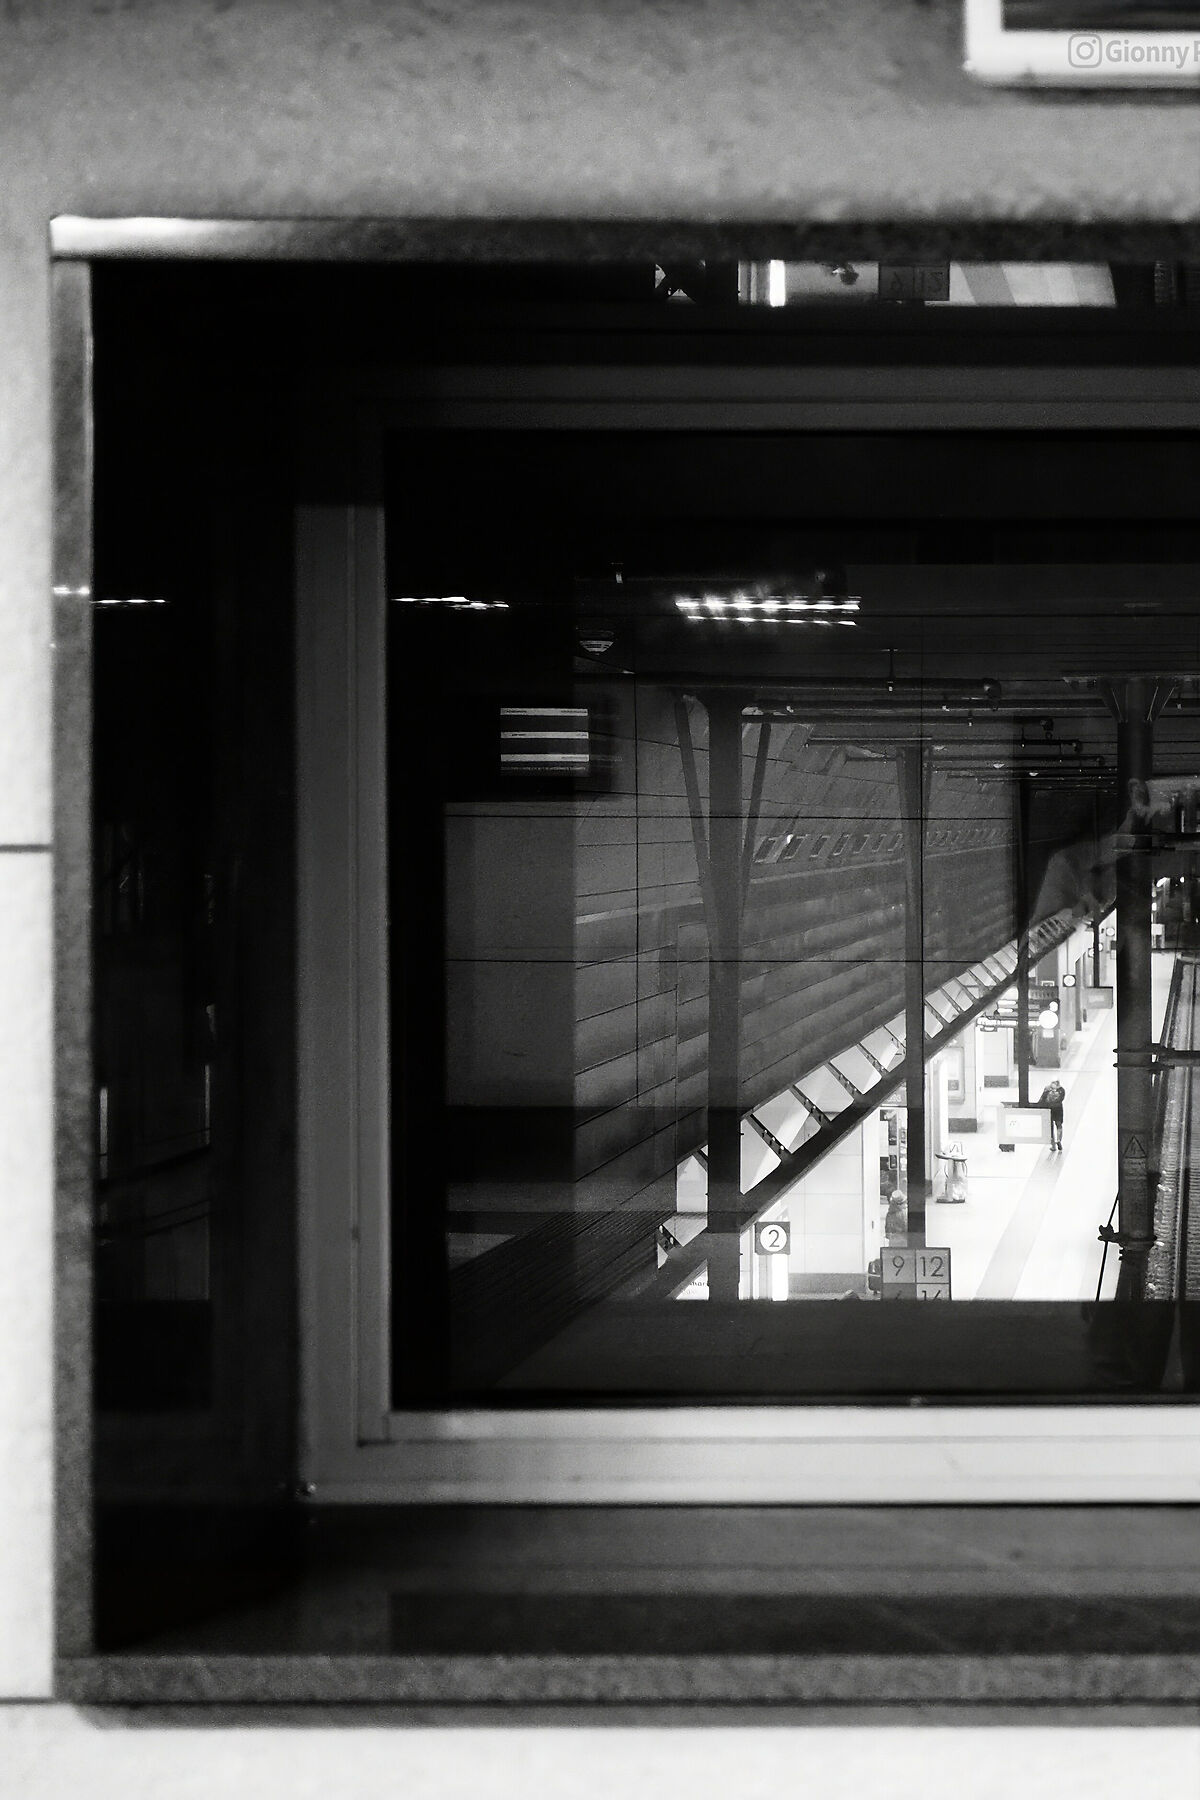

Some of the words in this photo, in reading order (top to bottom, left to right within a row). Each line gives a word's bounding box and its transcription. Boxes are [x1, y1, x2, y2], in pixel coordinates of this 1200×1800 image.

[768, 1229, 780, 1248] 2
[892, 1255, 905, 1277] 9
[919, 1256, 944, 1277] 12
